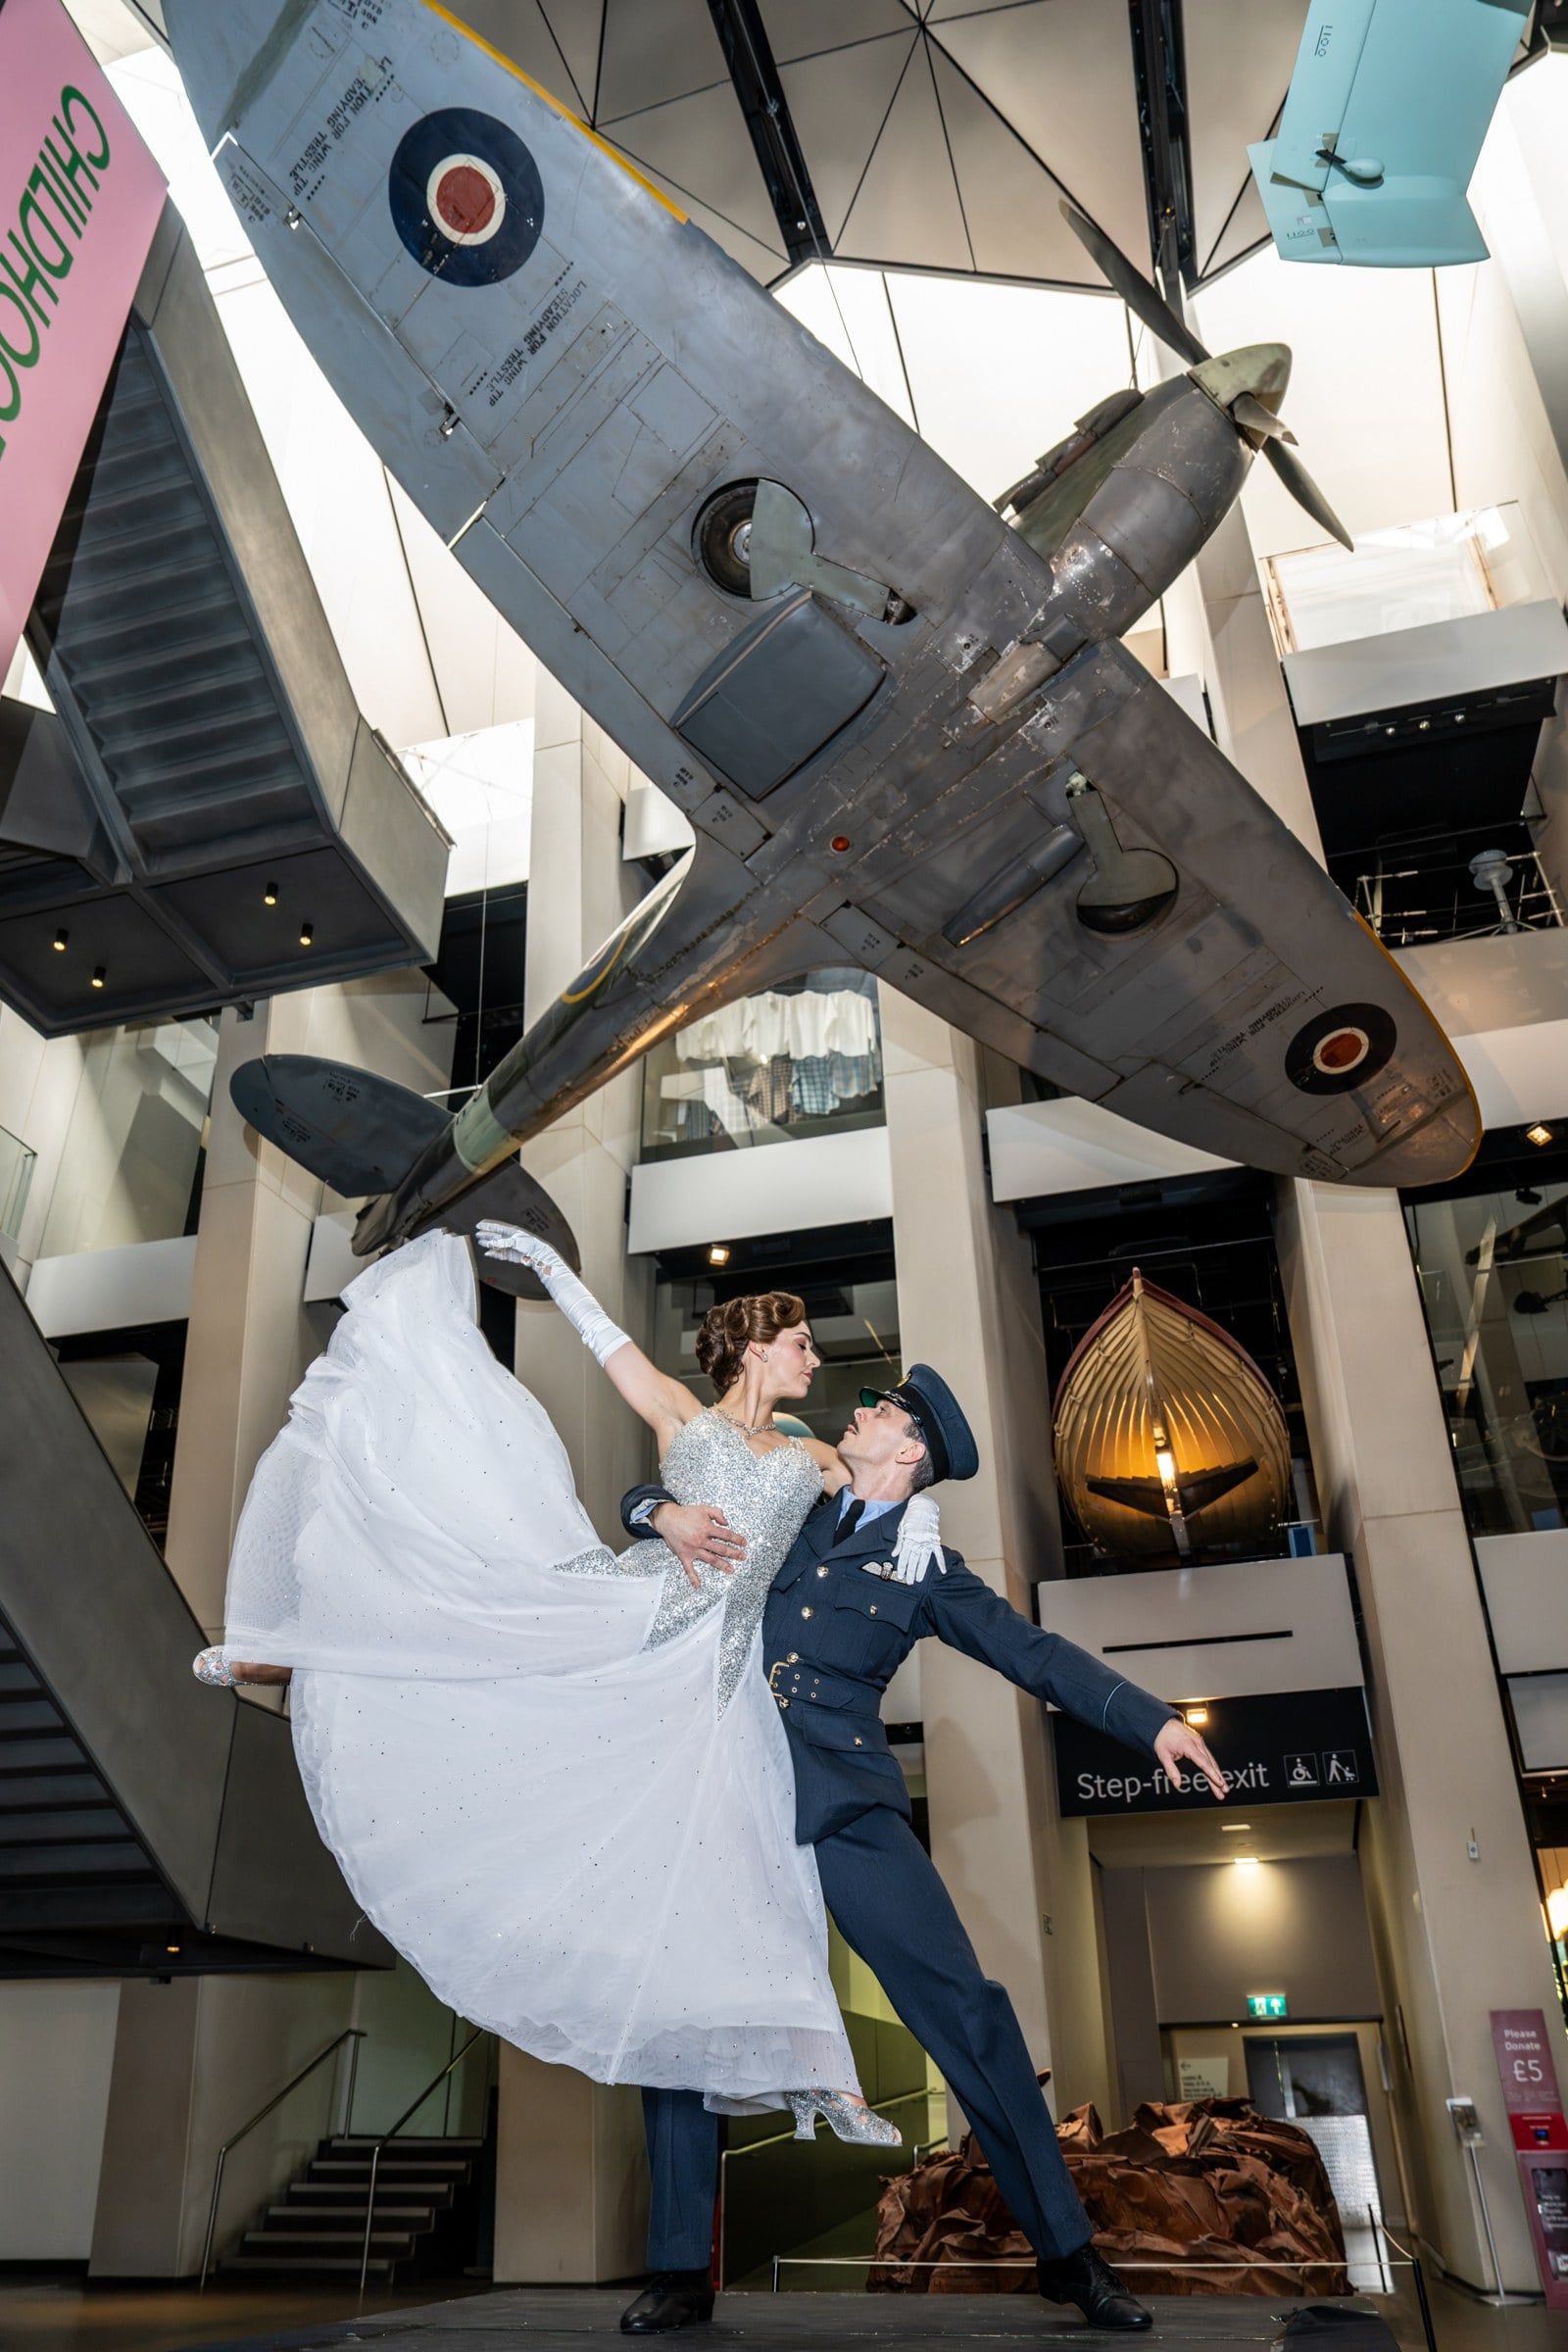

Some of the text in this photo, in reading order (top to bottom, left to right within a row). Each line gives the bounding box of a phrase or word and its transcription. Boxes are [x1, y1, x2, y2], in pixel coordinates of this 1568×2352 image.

[331, 117, 352, 141] FOR
[289, 131, 328, 182] TRESTLE
[308, 142, 333, 174] WING
[294, 179, 309, 197] TIP
[487, 288, 569, 392] STEADYING TRESTLE
[489, 280, 588, 407] LOCATION FOR WING TIP
[1077, 1768, 1211, 1803] Step-free
[1504, 2029, 1537, 2038] Please
[1504, 2041, 1542, 2051] Donate
[1513, 2059, 1544, 2082] £5
